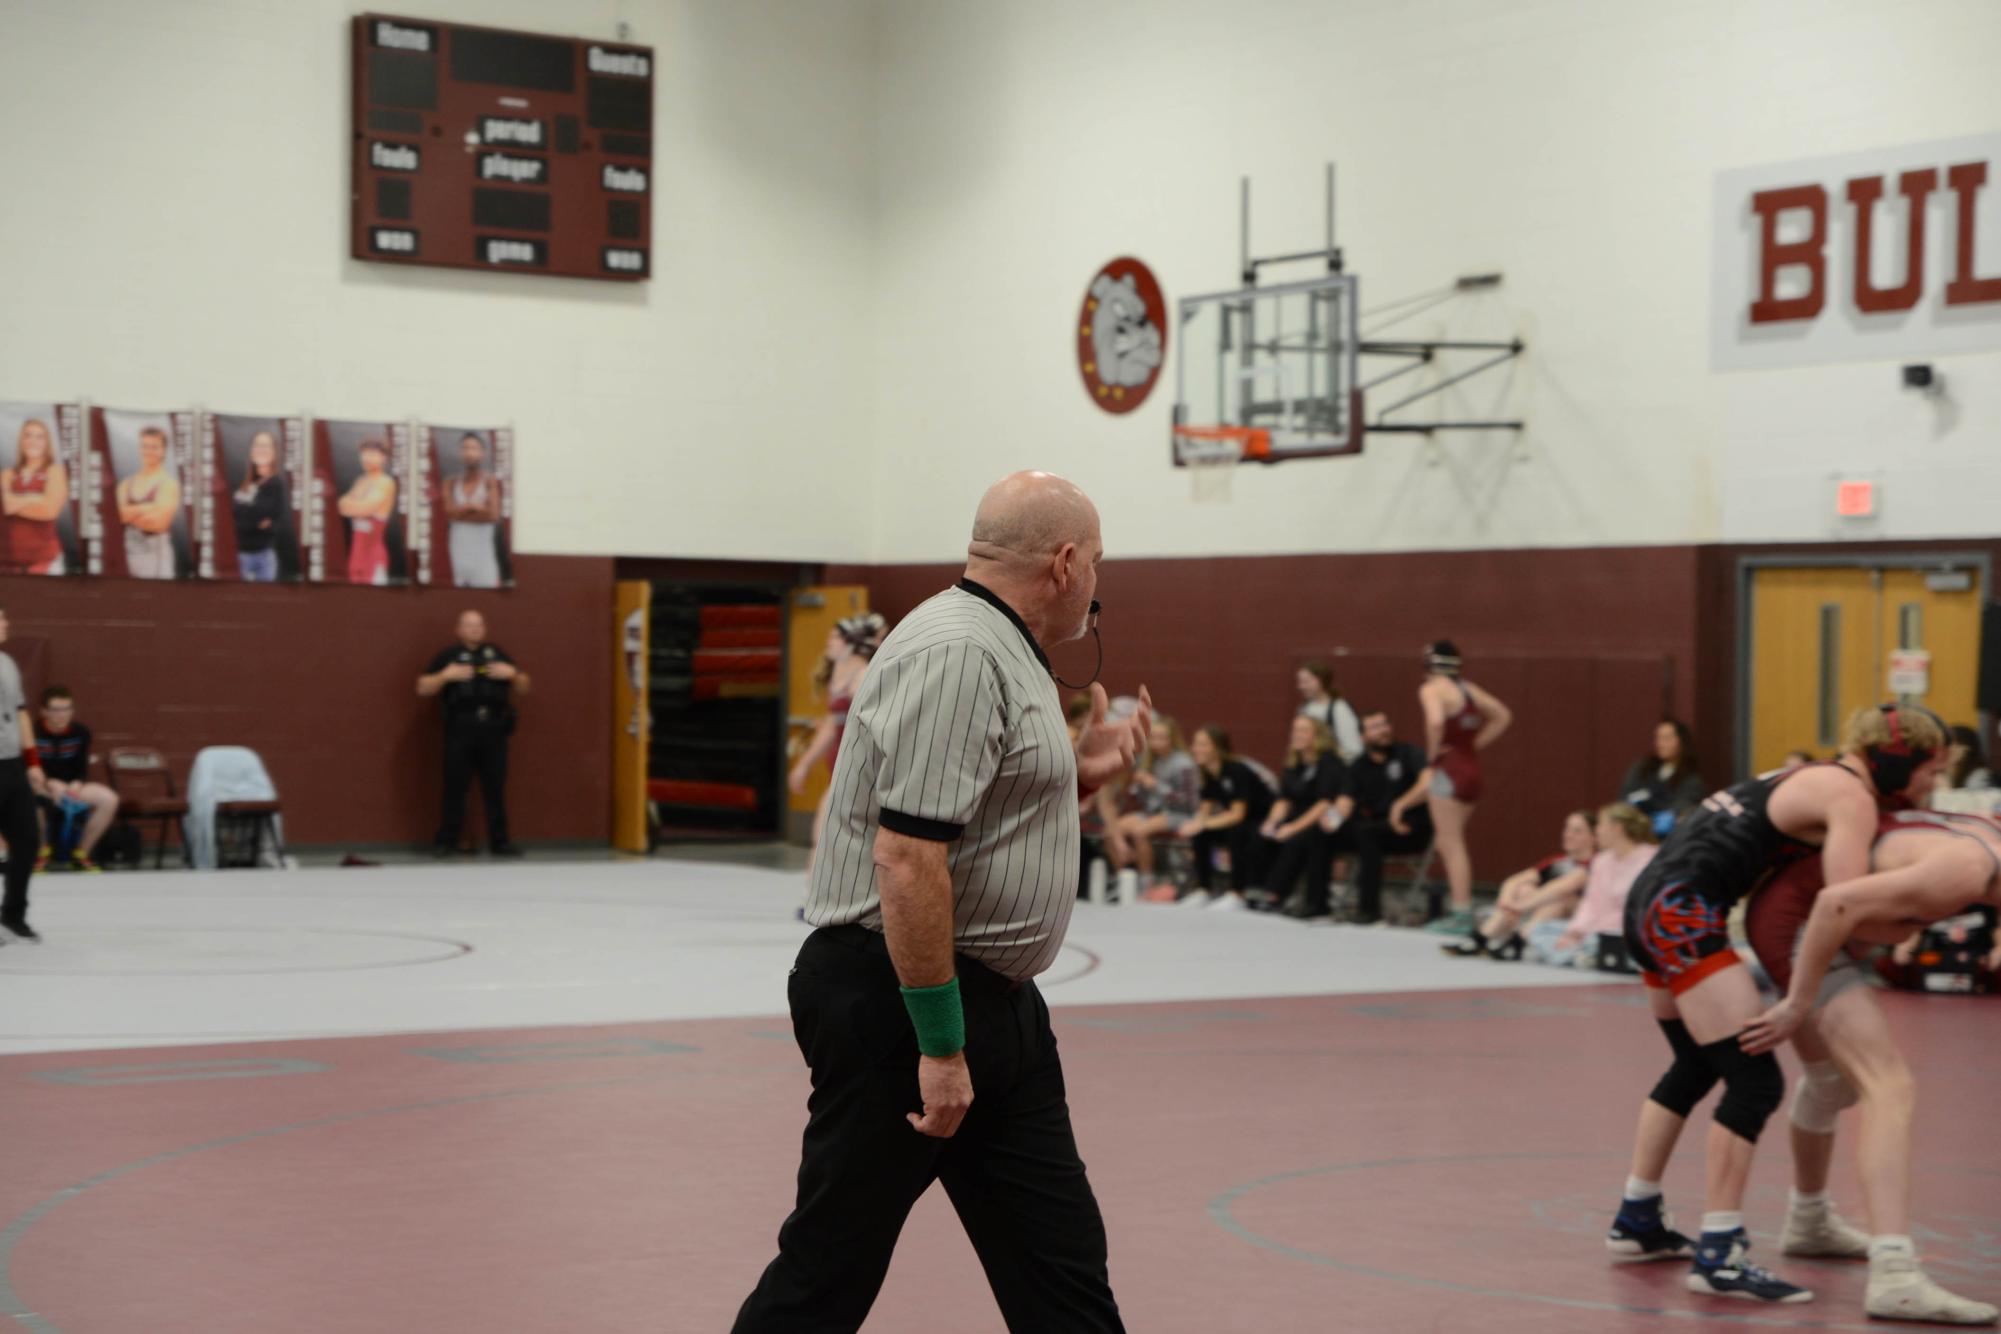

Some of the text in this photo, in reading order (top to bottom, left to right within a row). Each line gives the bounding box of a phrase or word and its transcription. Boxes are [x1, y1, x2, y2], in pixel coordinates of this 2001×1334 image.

[484, 119, 541, 143] period
[482, 153, 542, 182] player
[487, 241, 534, 263] game
[1750, 160, 2001, 325] BUL
